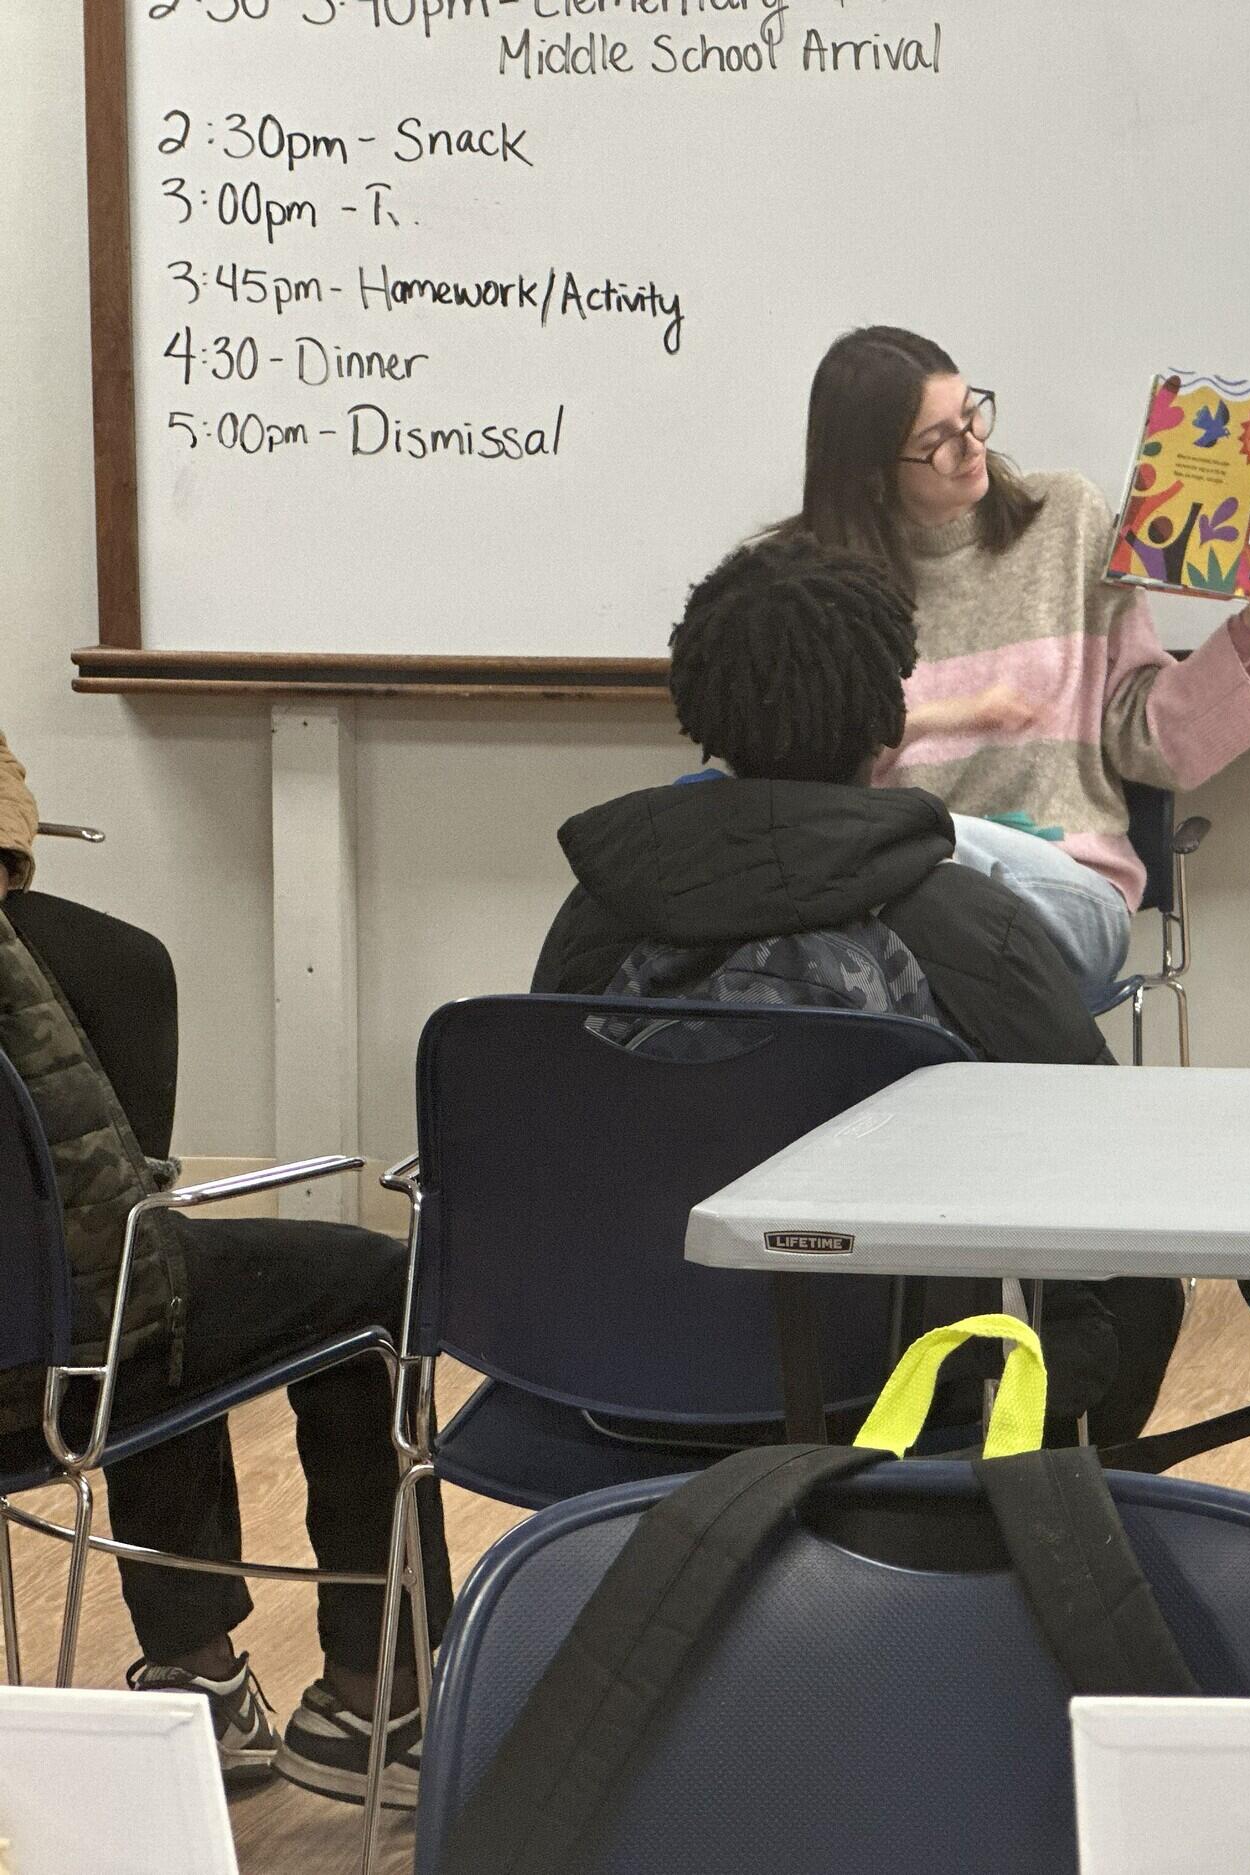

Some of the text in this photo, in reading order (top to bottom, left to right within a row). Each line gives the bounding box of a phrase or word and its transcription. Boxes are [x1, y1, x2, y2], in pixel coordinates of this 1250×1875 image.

[500, 23, 940, 78] Middle School Arrival
[158, 109, 347, 170] 2:30pm
[394, 118, 533, 166] Snack
[162, 178, 316, 244] 3:00pm
[168, 261, 322, 314] 3:45pm
[163, 326, 259, 384] 4:30
[296, 336, 429, 386] Dinner
[168, 412, 308, 454] 5:00pm
[347, 404, 565, 459] Dismissal
[776, 1236, 843, 1249] LIFETIME
